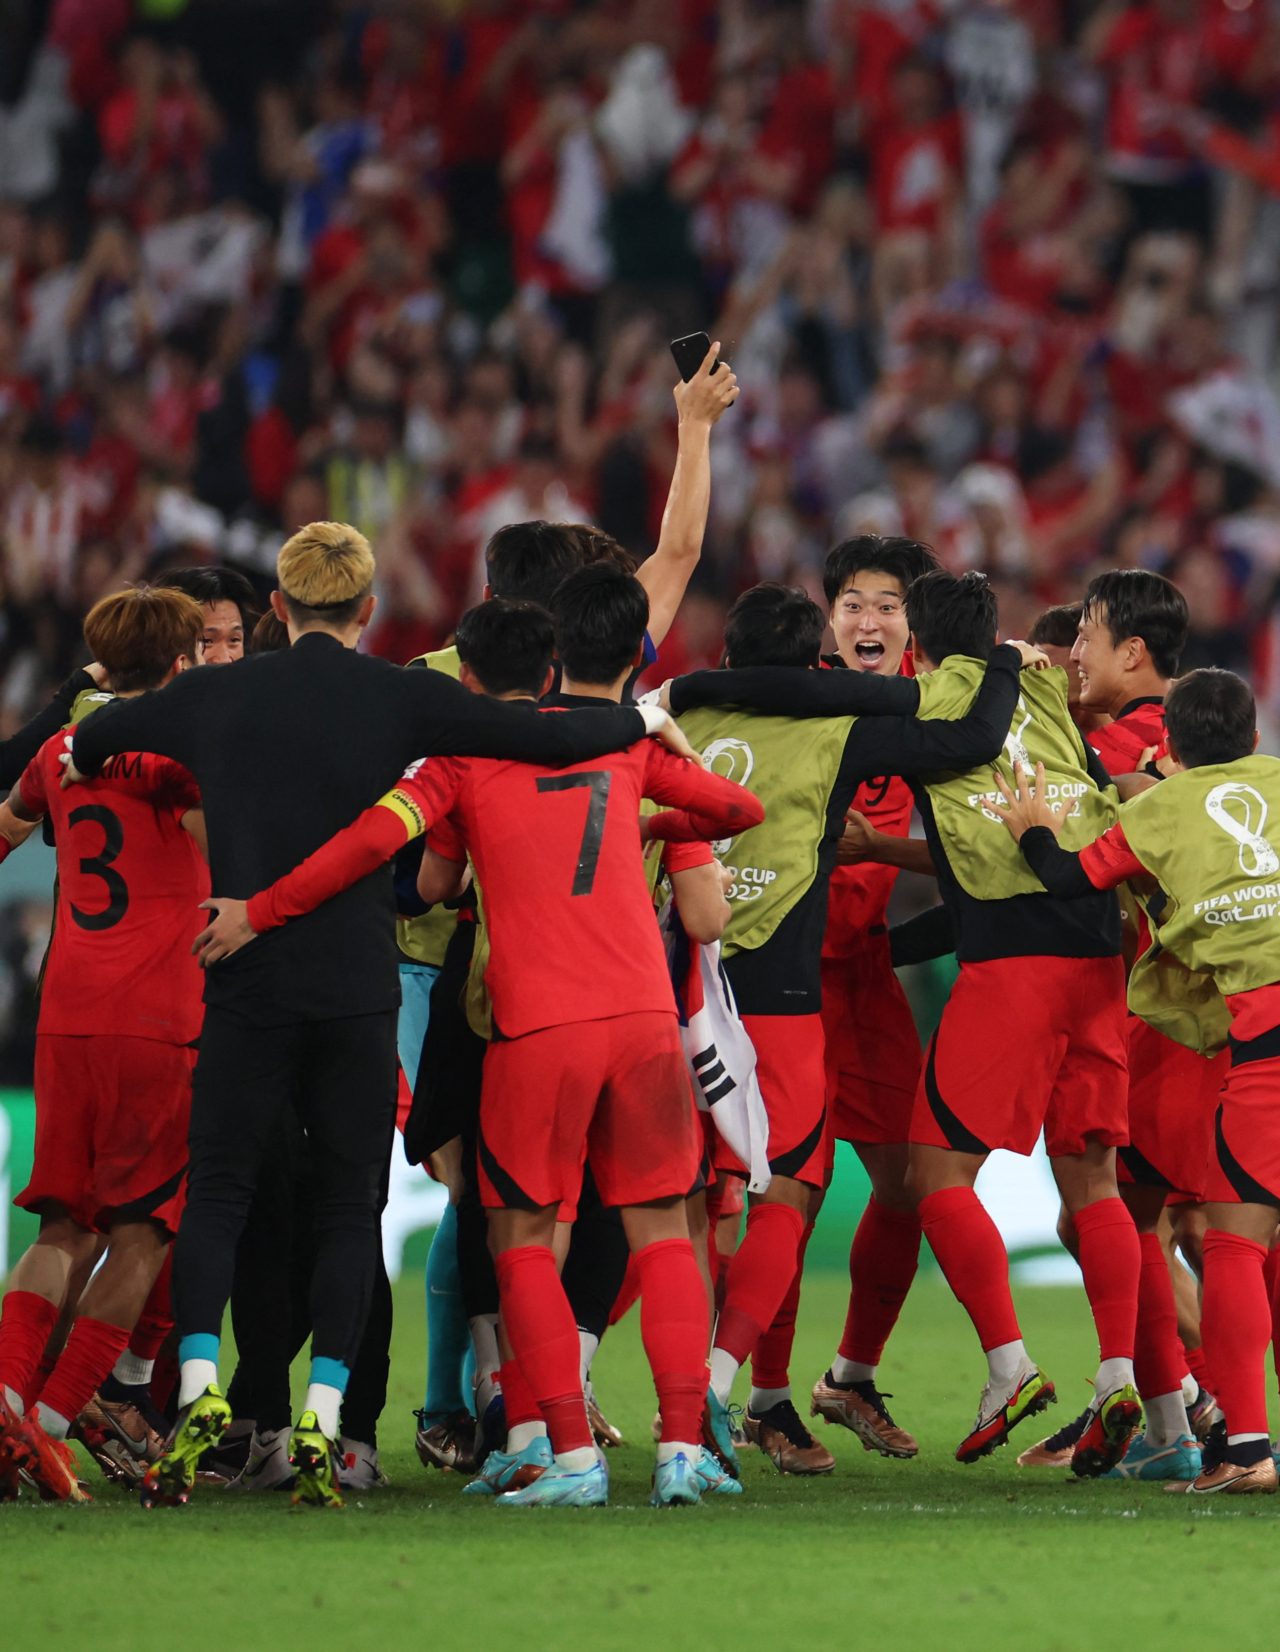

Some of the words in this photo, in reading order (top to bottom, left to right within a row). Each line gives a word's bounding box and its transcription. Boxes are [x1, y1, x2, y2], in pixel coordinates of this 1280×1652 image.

[865, 774, 891, 807] 9
[1061, 784, 1088, 798] CUP
[535, 770, 612, 896] 7
[68, 804, 129, 931] 3
[740, 867, 777, 885] CUP
[1193, 894, 1232, 915] FIFA
